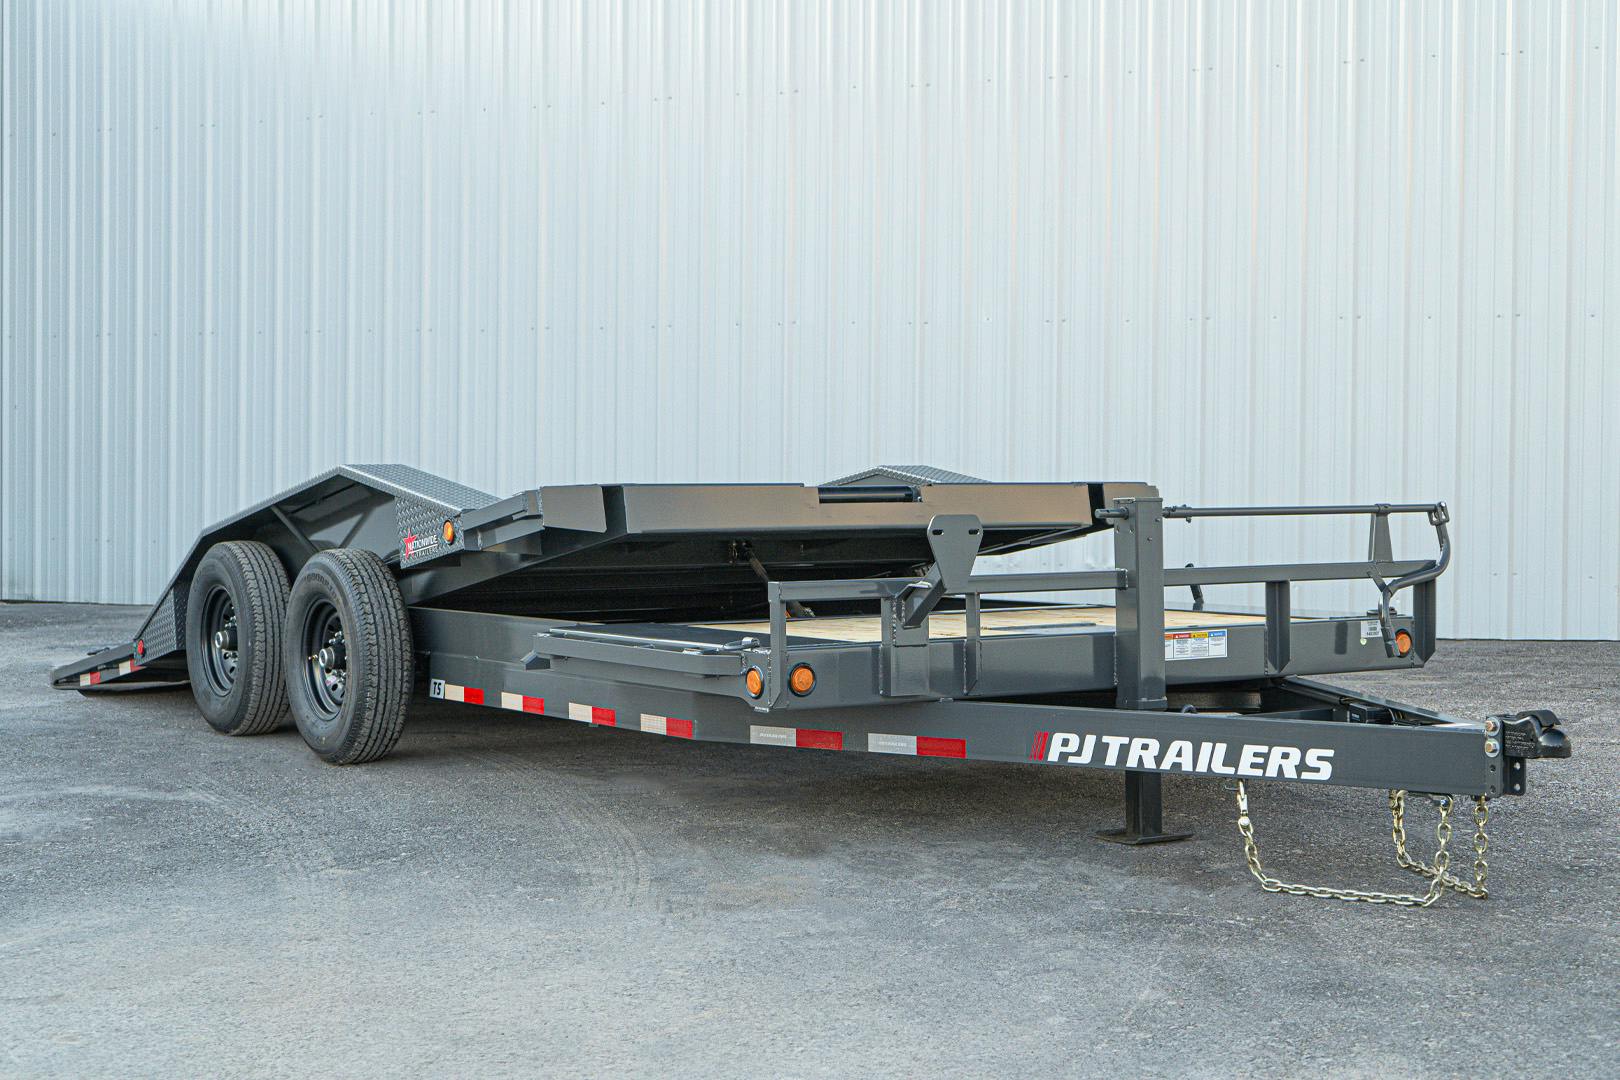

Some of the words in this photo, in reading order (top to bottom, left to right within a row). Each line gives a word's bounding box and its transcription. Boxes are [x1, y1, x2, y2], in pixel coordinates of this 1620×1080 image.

[433, 681, 441, 696] TS
[1047, 732, 1097, 764] PJ
[1101, 735, 1335, 781] TRAILERS
